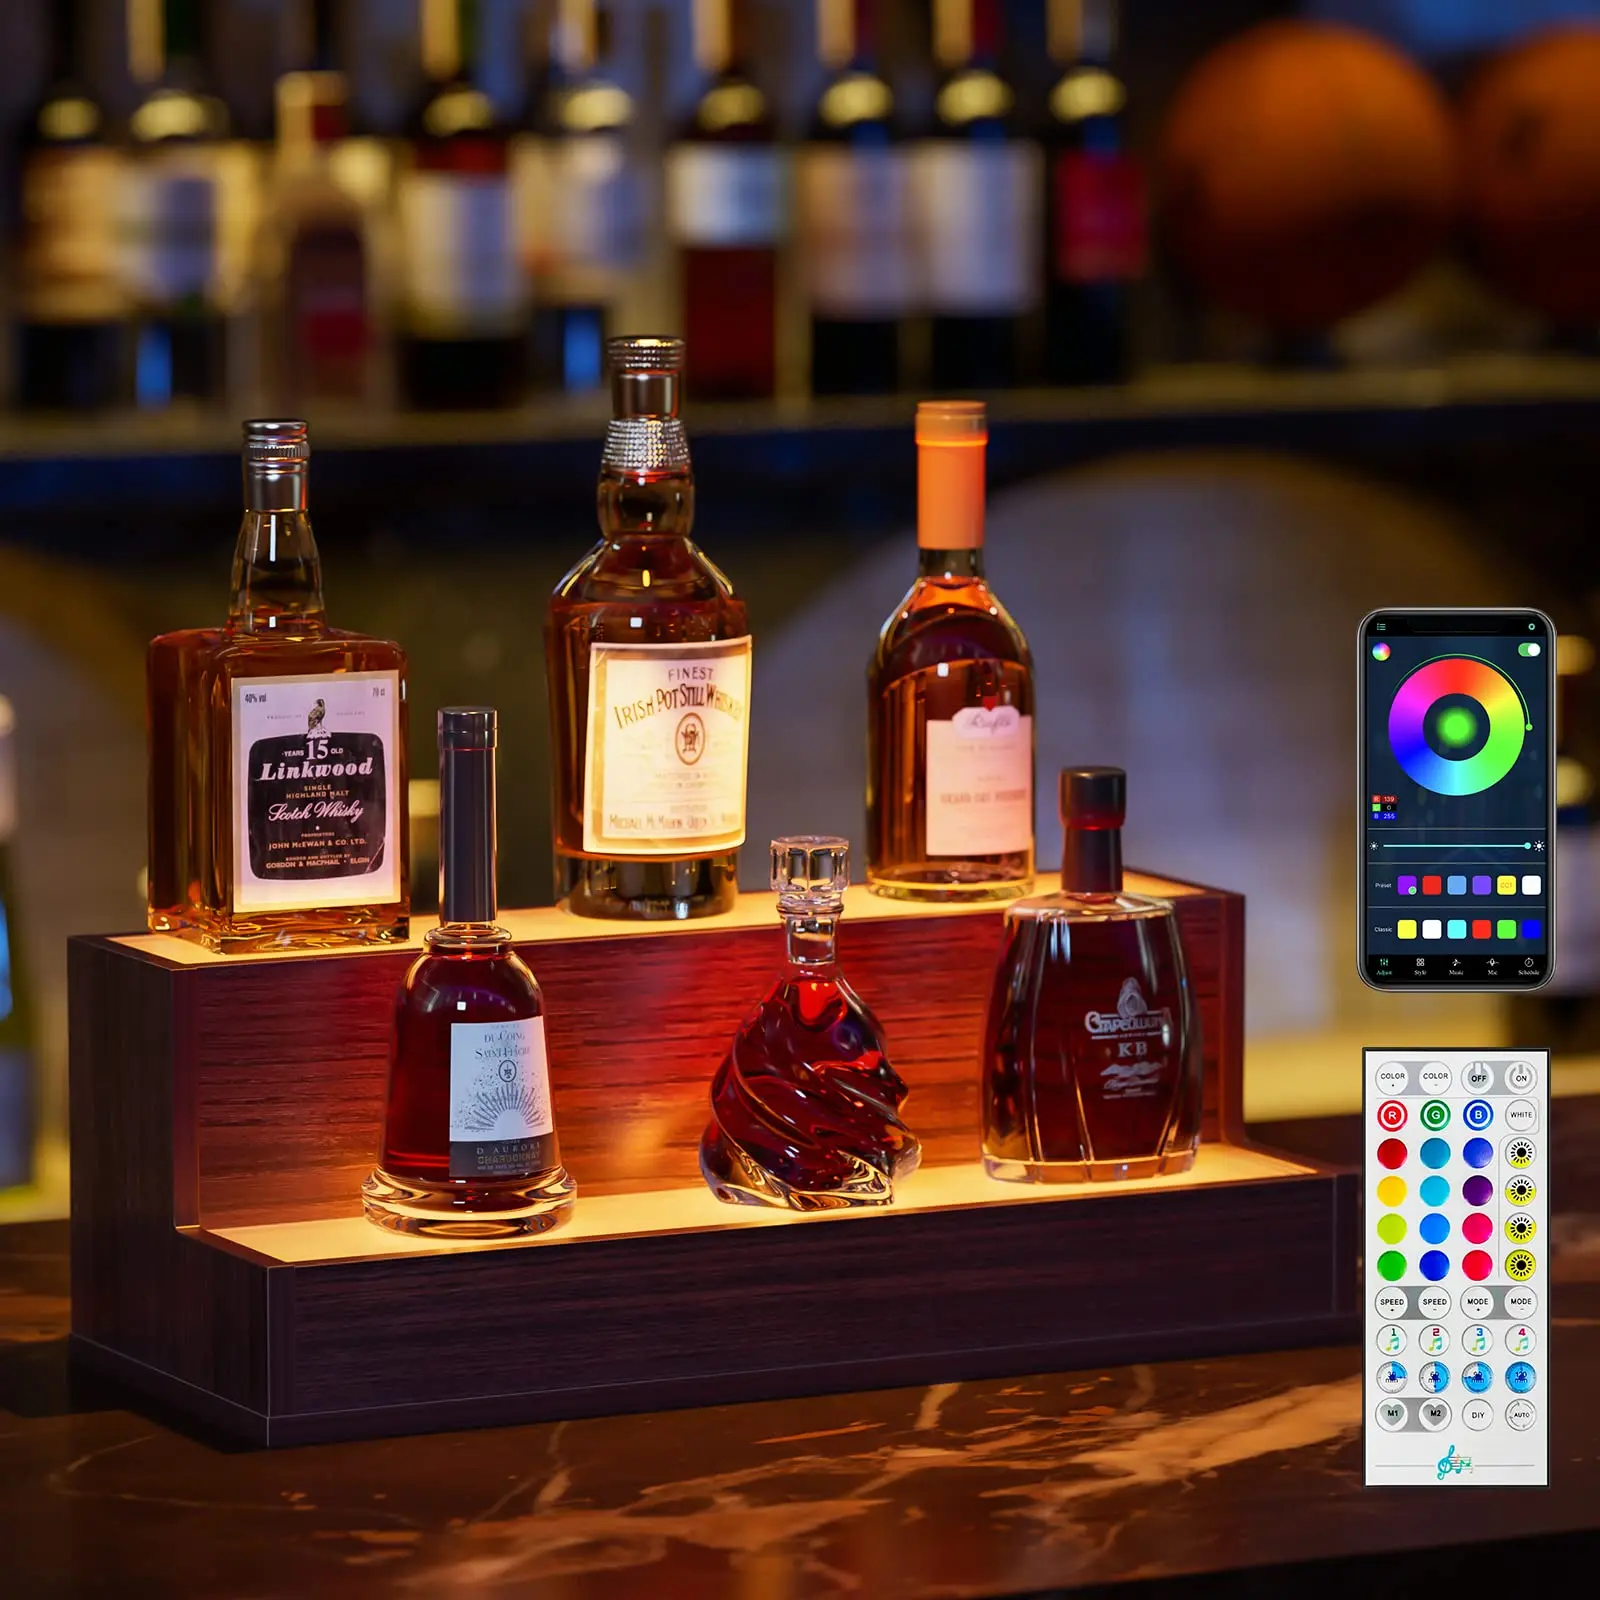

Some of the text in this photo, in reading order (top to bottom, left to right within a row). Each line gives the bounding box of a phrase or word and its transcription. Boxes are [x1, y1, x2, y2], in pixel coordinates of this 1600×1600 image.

[668, 666, 714, 681] FINEST
[244, 692, 267, 703] 40% vol
[614, 694, 655, 729] IRISH
[656, 688, 678, 712] POT
[680, 683, 704, 707] STILL
[306, 739, 328, 760] 15
[260, 757, 373, 781] Linkwood
[286, 790, 349, 799] HIGHLAND MALT
[268, 800, 364, 823] Scotch Whisky
[269, 840, 289, 849] JOHN
[292, 840, 325, 848] McEWAN
[335, 838, 348, 846] CO.
[266, 861, 296, 869] GORDON
[1388, 1111, 1396, 1119] R
[1431, 1111, 1441, 1119] G
[1475, 1110, 1483, 1119] B
[477, 1151, 540, 1165] CHARDONNAY
[1432, 1328, 1440, 1336] 2
[1476, 1328, 1483, 1336] 3
[1518, 1328, 1526, 1336] 4
